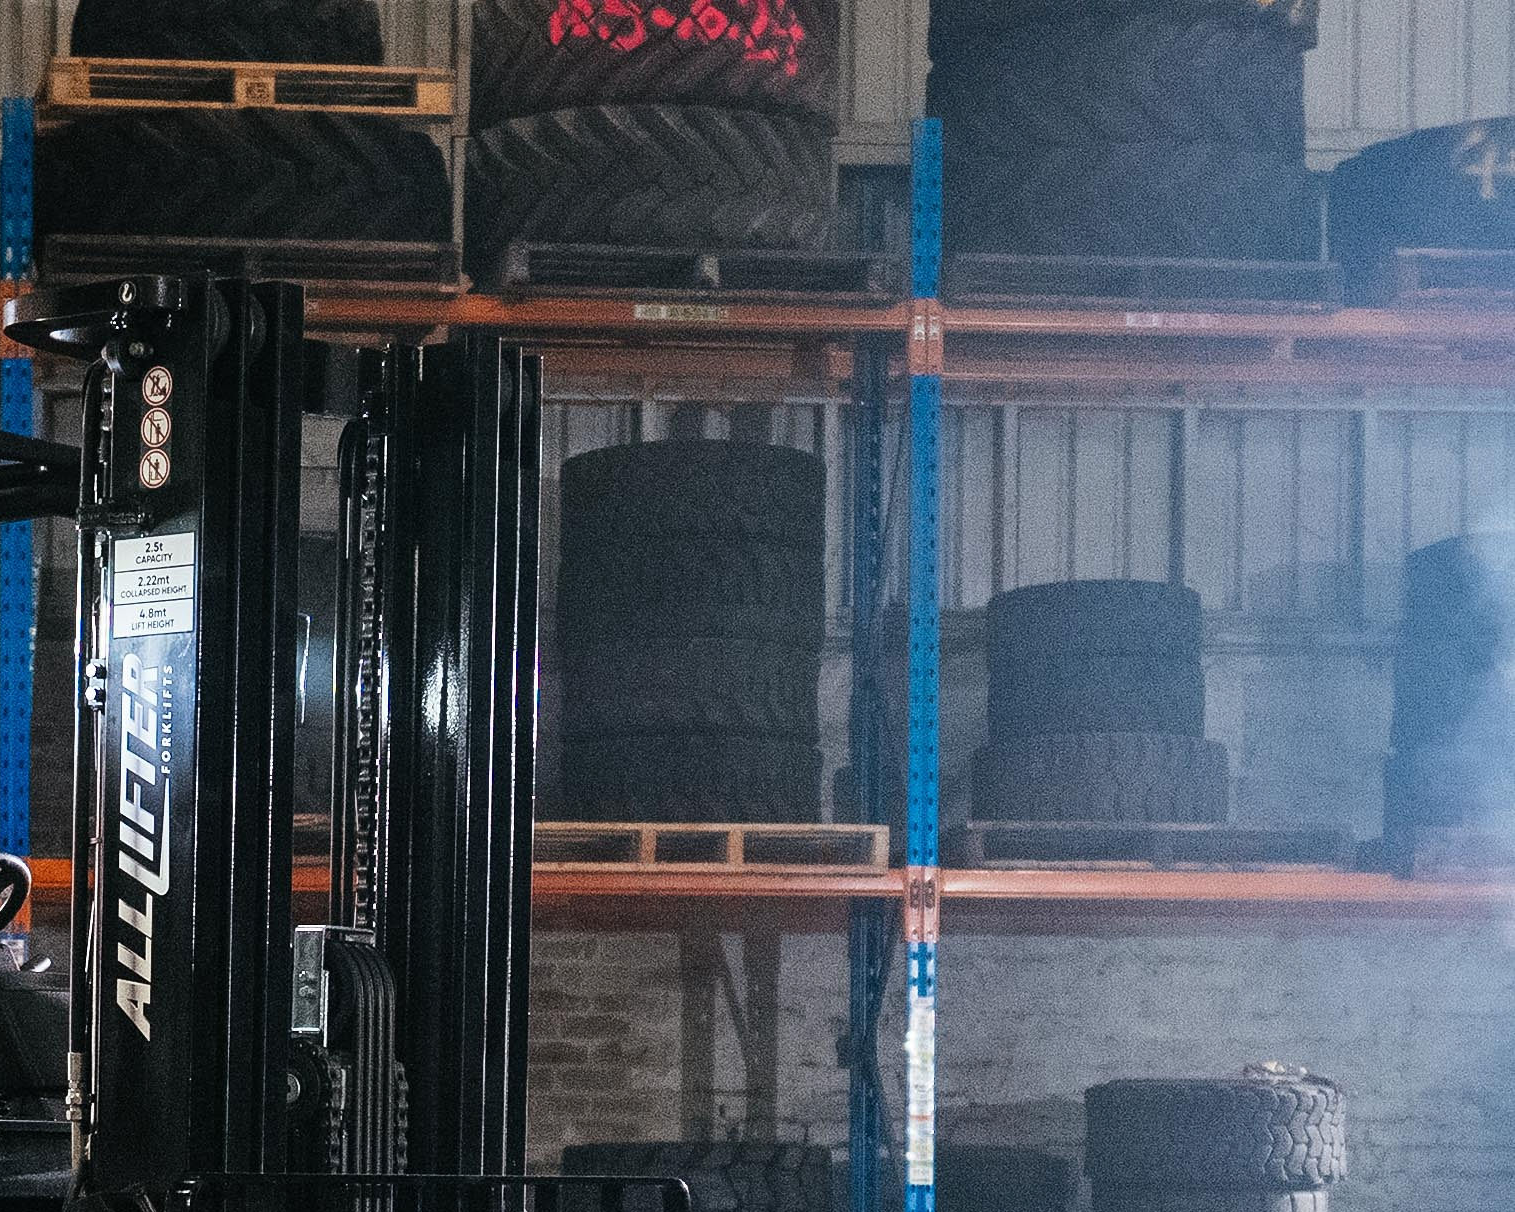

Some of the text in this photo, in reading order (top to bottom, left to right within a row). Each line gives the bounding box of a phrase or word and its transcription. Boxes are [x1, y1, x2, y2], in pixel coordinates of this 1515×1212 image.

[145, 541, 164, 553] 2.5t
[135, 553, 173, 565] CAPACITY
[137, 575, 170, 587] 2.22mt
[120, 585, 187, 599] COLLAPSED HEIGHT
[139, 608, 167, 619] 4.8mt
[131, 619, 175, 631] LIFT HEIGHT
[160, 665, 174, 774] FORKLIFTS
